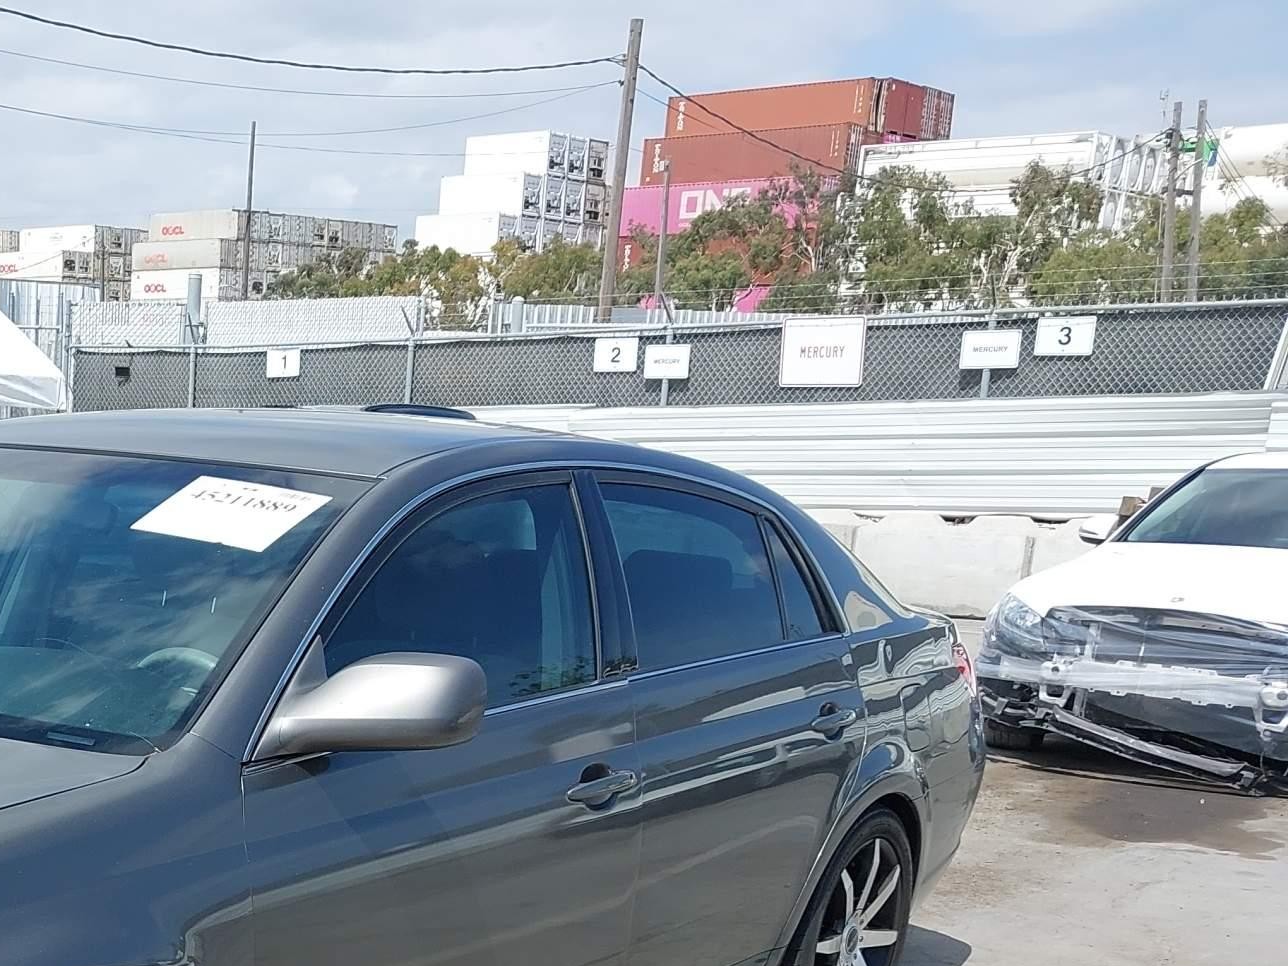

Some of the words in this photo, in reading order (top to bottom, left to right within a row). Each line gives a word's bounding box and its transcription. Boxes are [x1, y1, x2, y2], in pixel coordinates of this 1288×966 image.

[1058, 326, 1072, 346] 3
[610, 347, 621, 363] 2
[799, 345, 846, 359] MERCURY
[972, 345, 1009, 353] MERCURY
[281, 354, 287, 369] 1
[191, 490, 297, 511] 45211889
